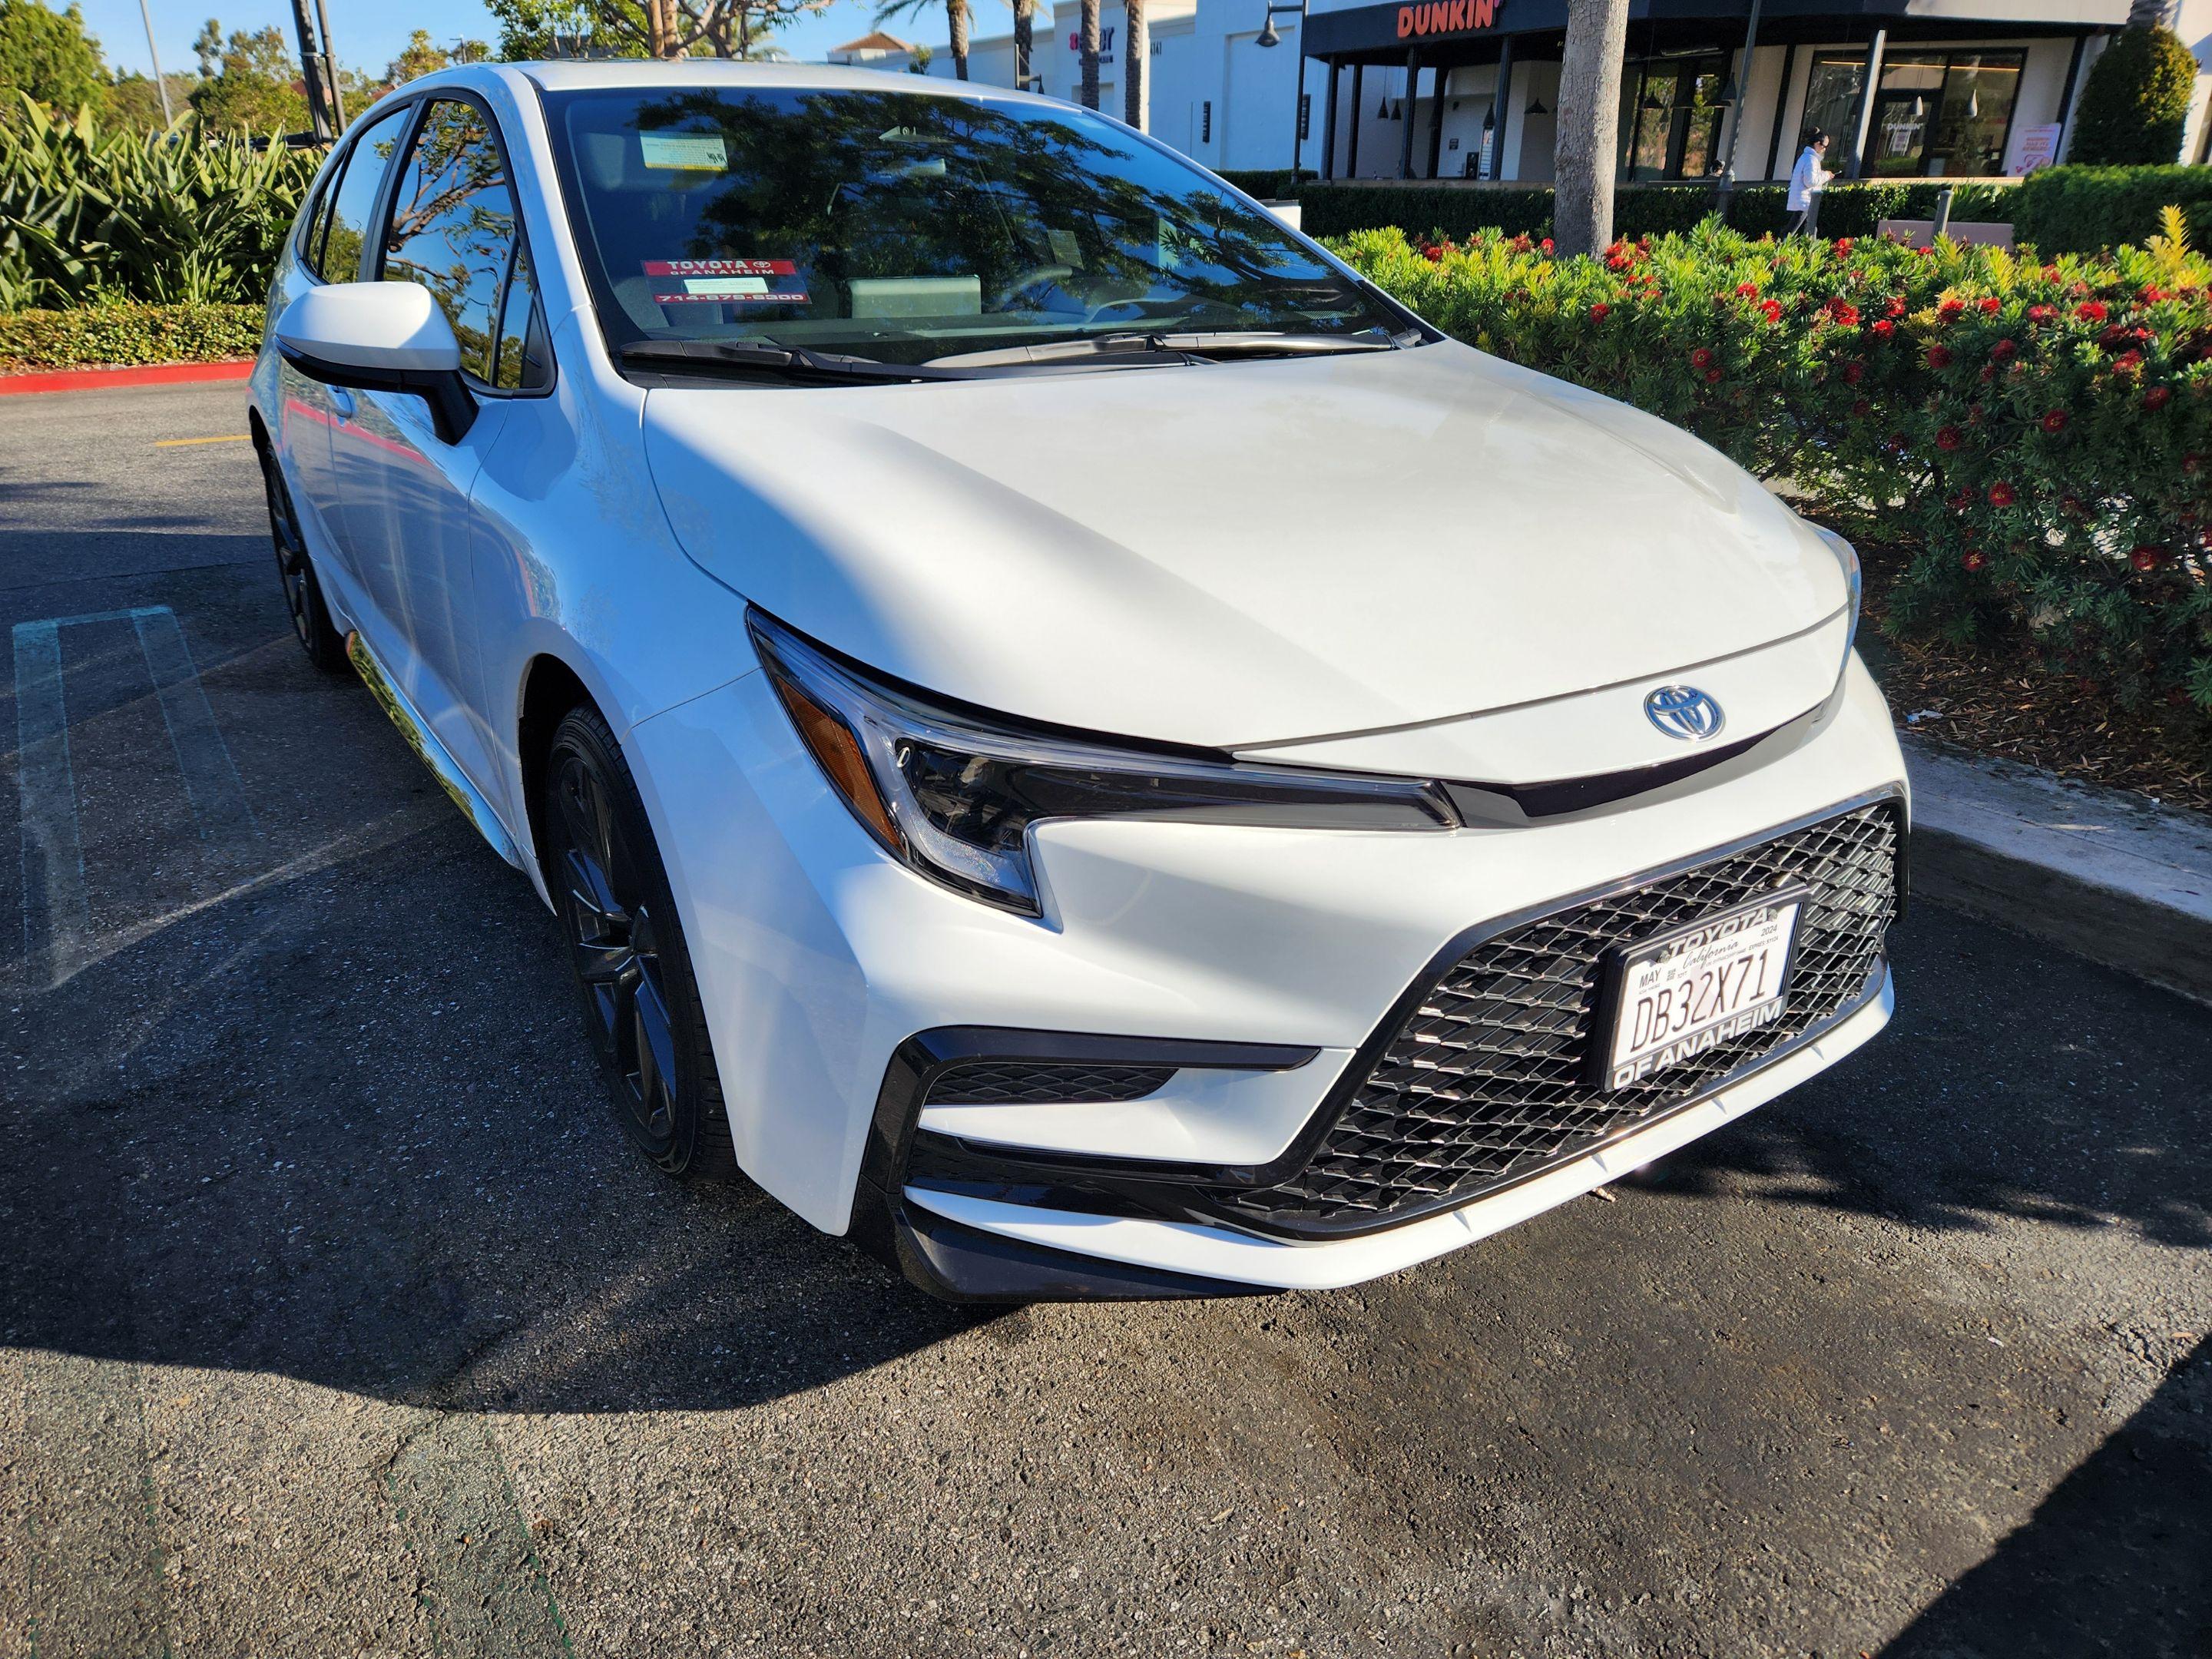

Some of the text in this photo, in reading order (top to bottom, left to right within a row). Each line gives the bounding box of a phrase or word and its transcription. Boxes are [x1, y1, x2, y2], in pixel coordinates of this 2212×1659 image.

[1397, 0, 1499, 38] DUNKIN'
[667, 260, 748, 270] TOYOTA
[1668, 907, 1768, 957] TOYOTA
[1760, 924, 1778, 937] 2024
[1683, 939, 1739, 969] California
[1639, 968, 1661, 988] MAY
[1631, 949, 1768, 1052] DB32X71
[1614, 999, 1780, 1089] OF ANAHEIM
